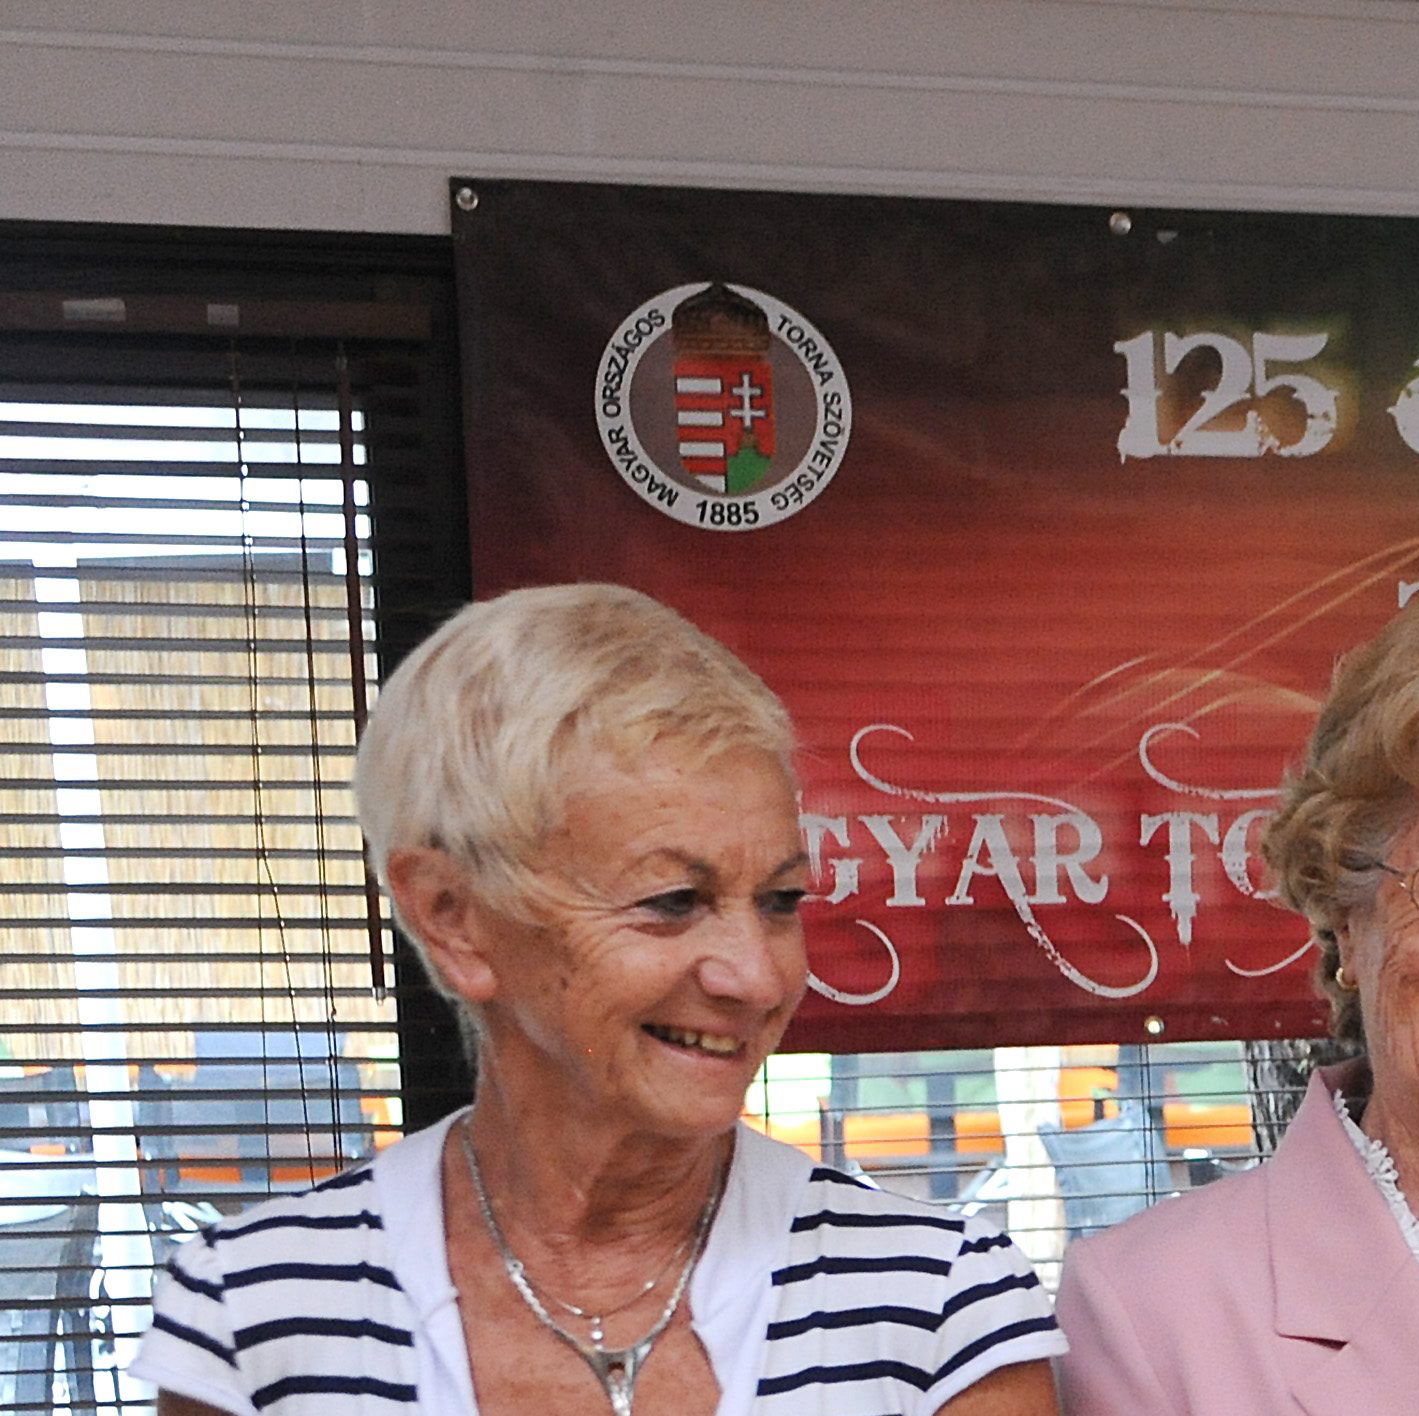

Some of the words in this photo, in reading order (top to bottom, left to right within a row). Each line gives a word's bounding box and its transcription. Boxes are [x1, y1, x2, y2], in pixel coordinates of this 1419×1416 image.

[602, 308, 665, 419] ORSZÁGOS
[774, 314, 833, 387] TORNA
[1113, 330, 1340, 464] 125
[607, 425, 679, 507] MAGYAR
[771, 391, 846, 511] SZÖVETSÉG
[696, 500, 760, 526] 1885
